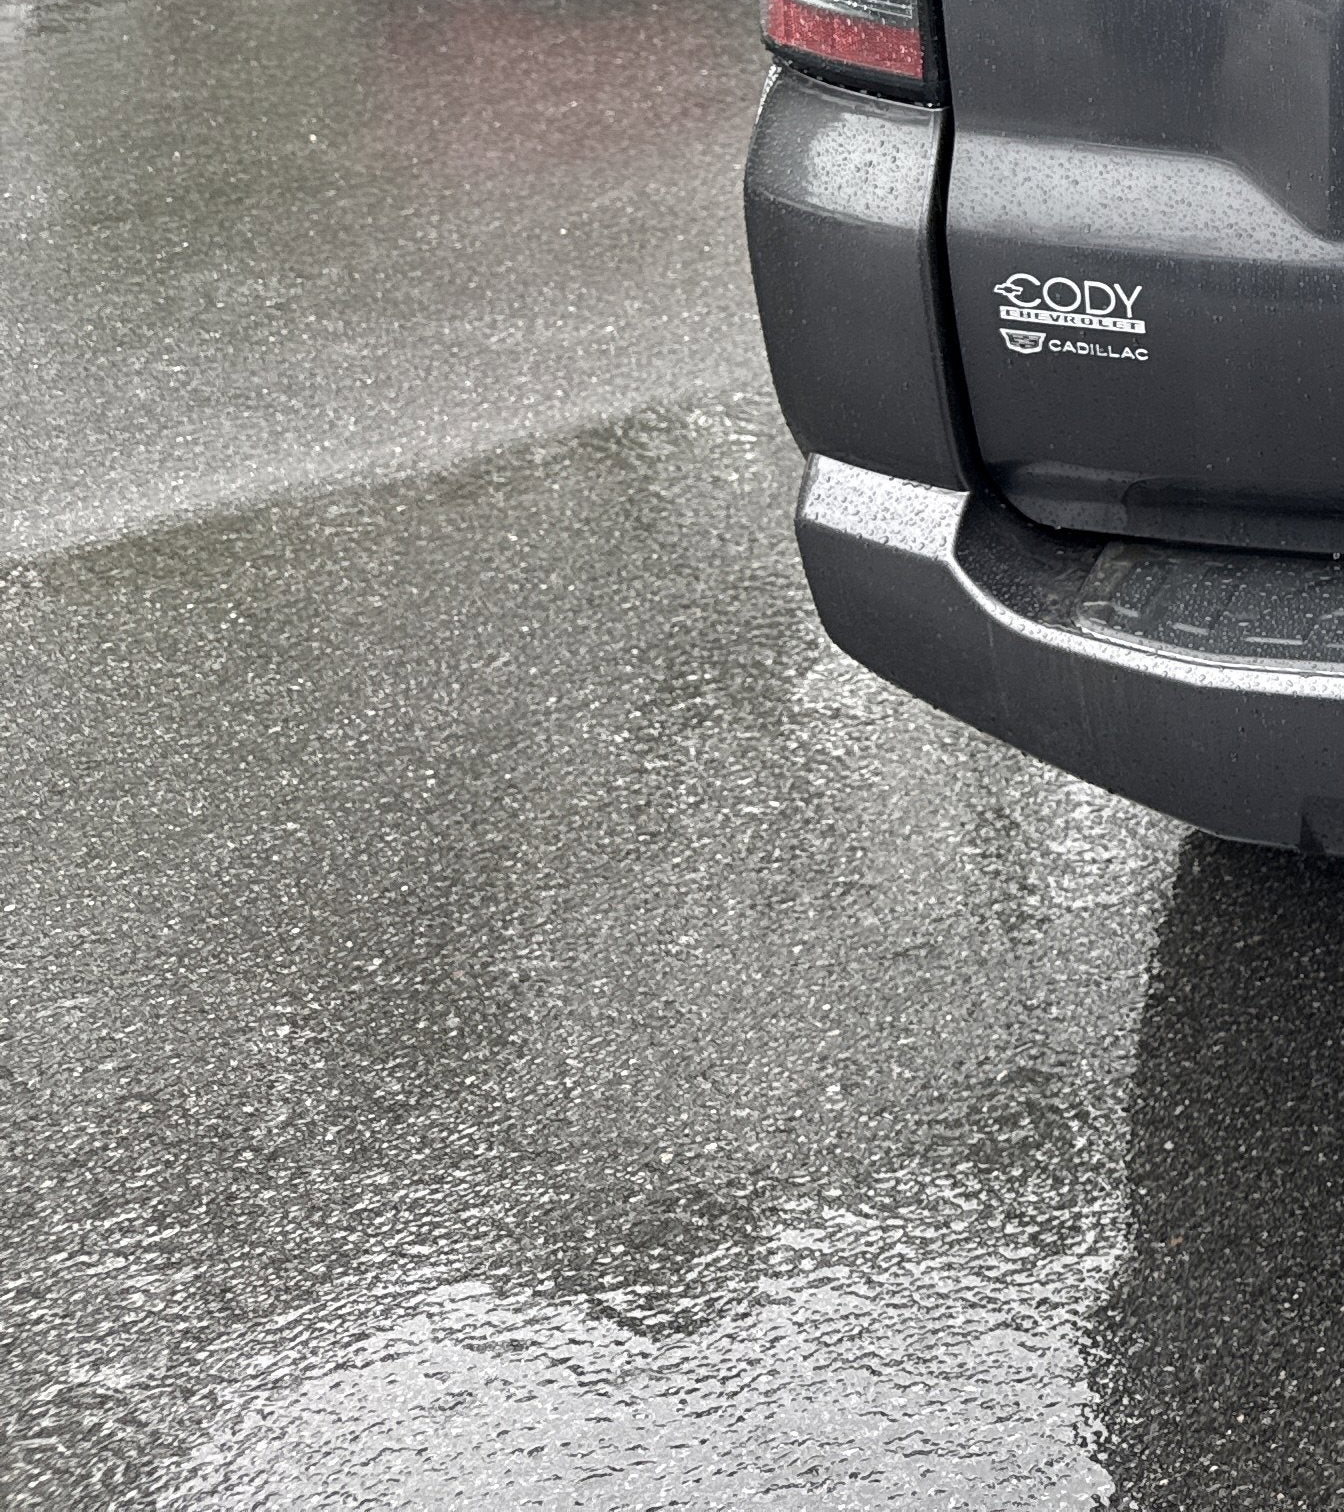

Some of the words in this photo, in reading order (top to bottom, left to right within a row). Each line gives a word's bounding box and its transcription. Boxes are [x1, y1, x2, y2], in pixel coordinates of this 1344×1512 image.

[994, 273, 1142, 318] CODY
[1004, 308, 1142, 332] CHEVROLET
[1049, 339, 1149, 361] CADILLAC
